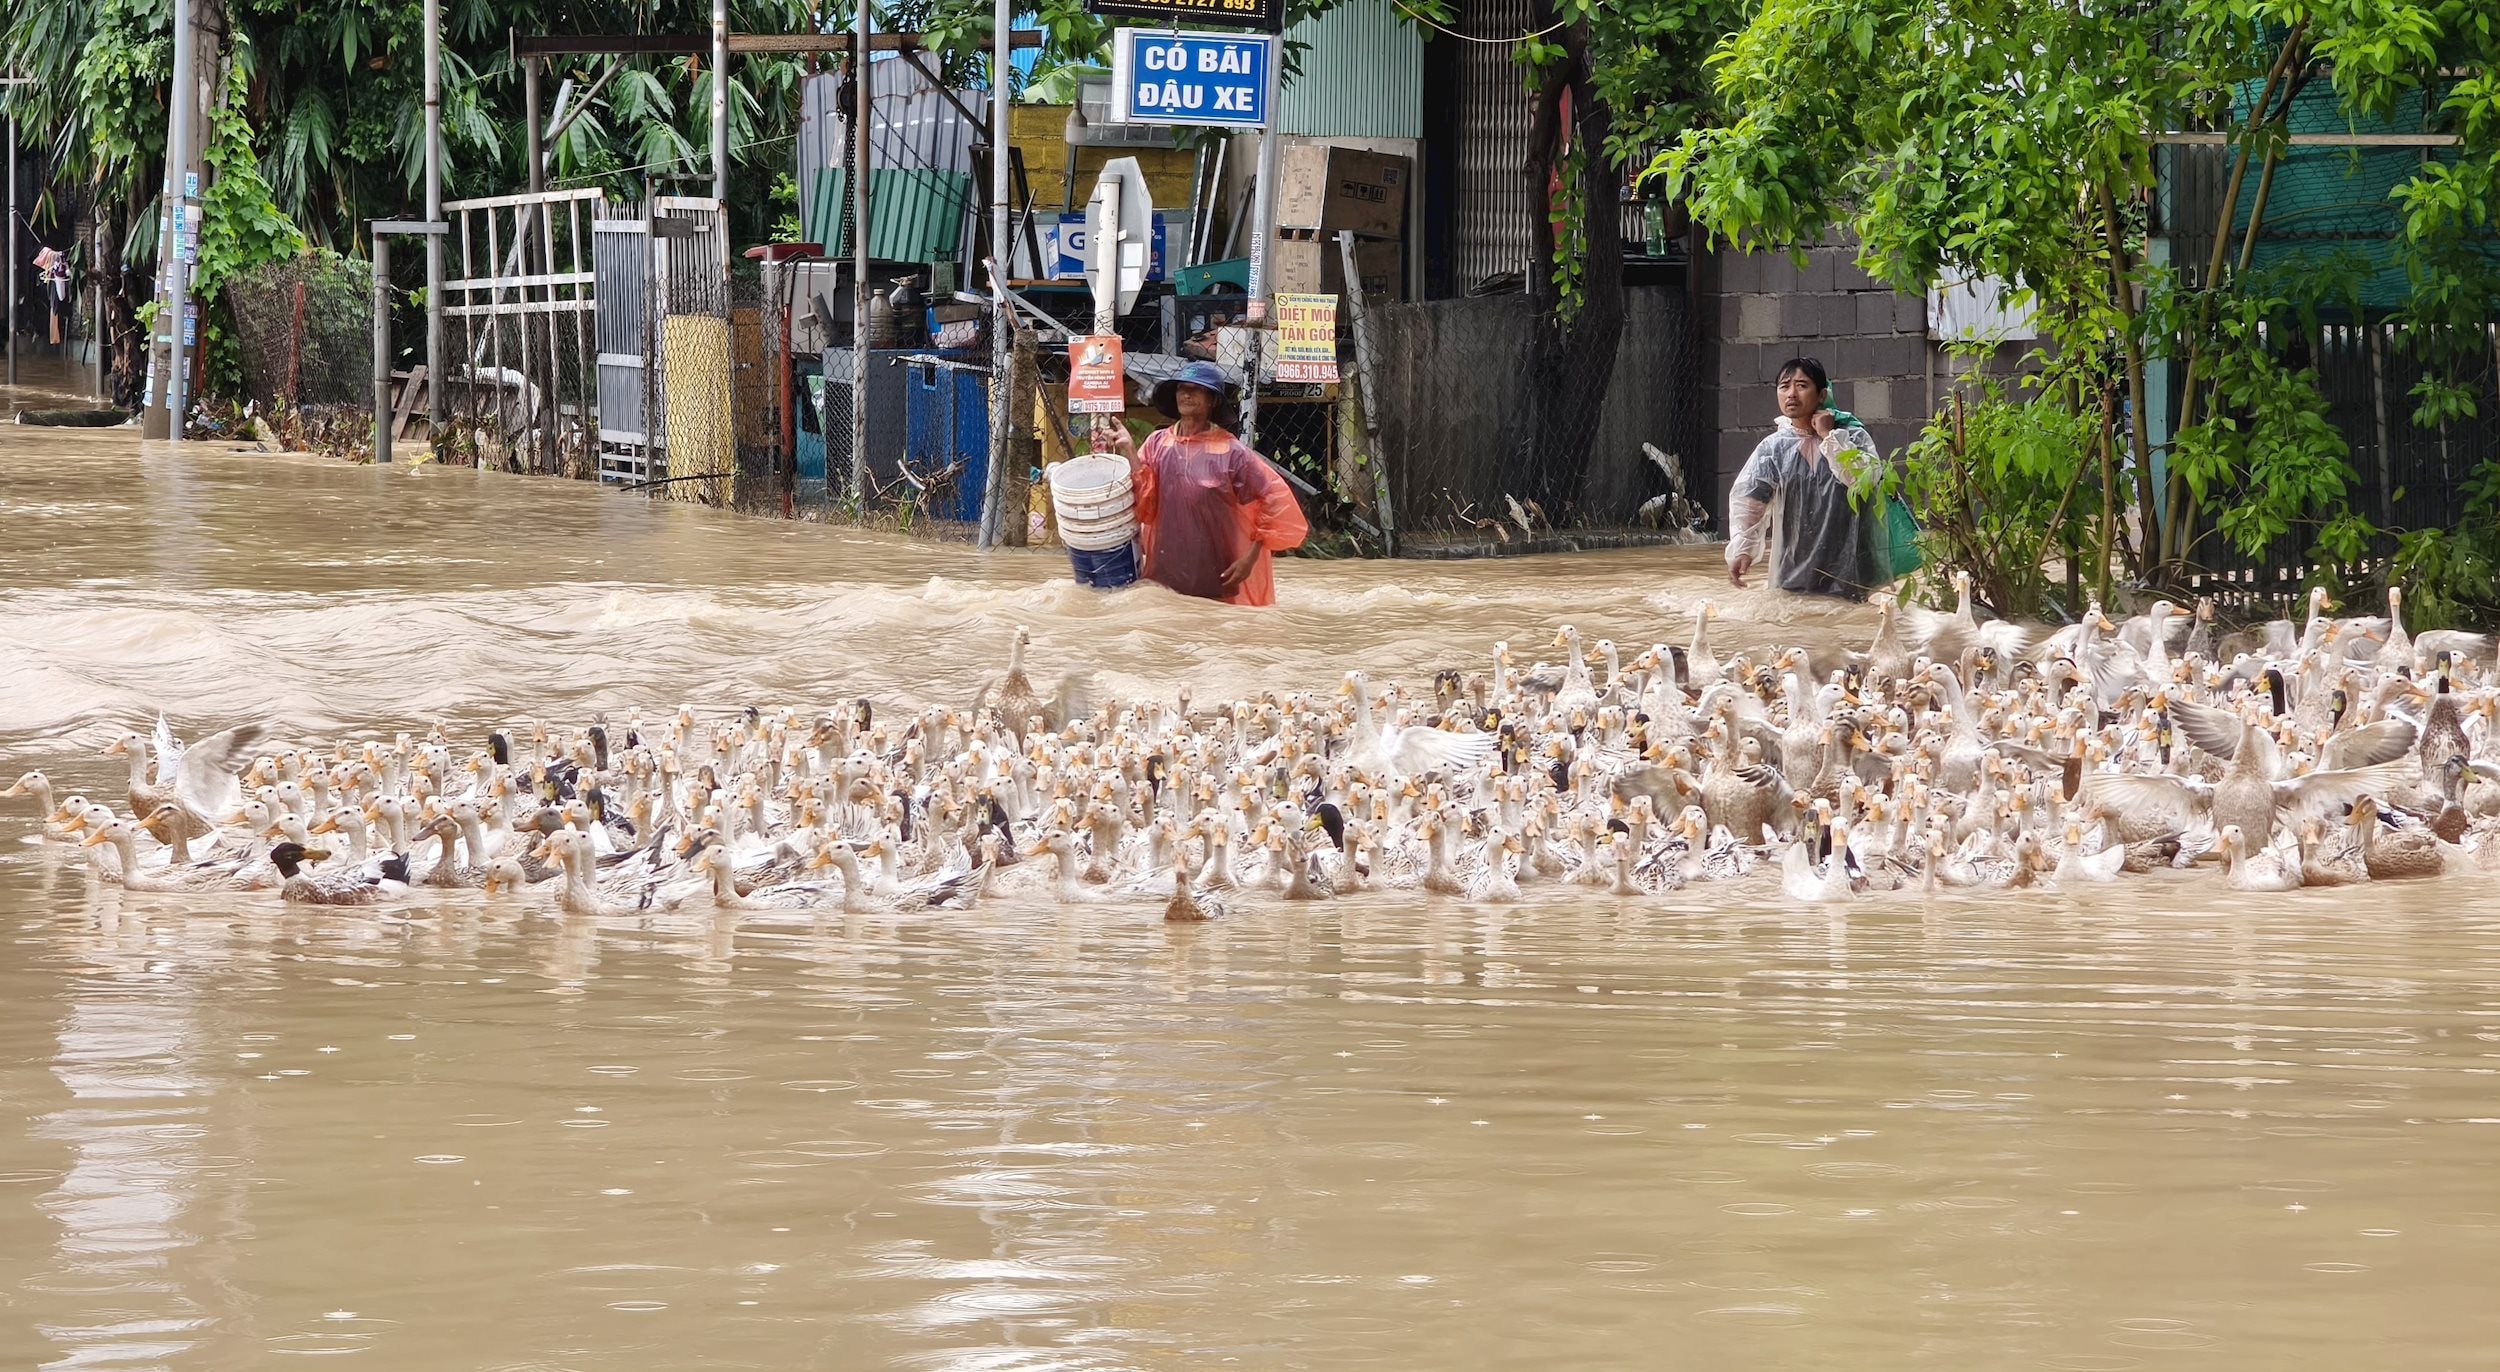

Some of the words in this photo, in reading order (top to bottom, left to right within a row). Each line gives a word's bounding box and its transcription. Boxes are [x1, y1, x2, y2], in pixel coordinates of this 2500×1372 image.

[1145, 42, 1187, 71] CÓ
[1198, 45, 1251, 74] BÃI
[1138, 79, 1203, 113] ĐẬU
[1213, 86, 1254, 111] XE
[1280, 305, 1306, 324] DIỆT
[1280, 324, 1305, 343] TẬN
[1310, 324, 1336, 341] GỐC
[1278, 363, 1338, 379] 0966.310.945
[1307, 383, 1322, 397] 25
